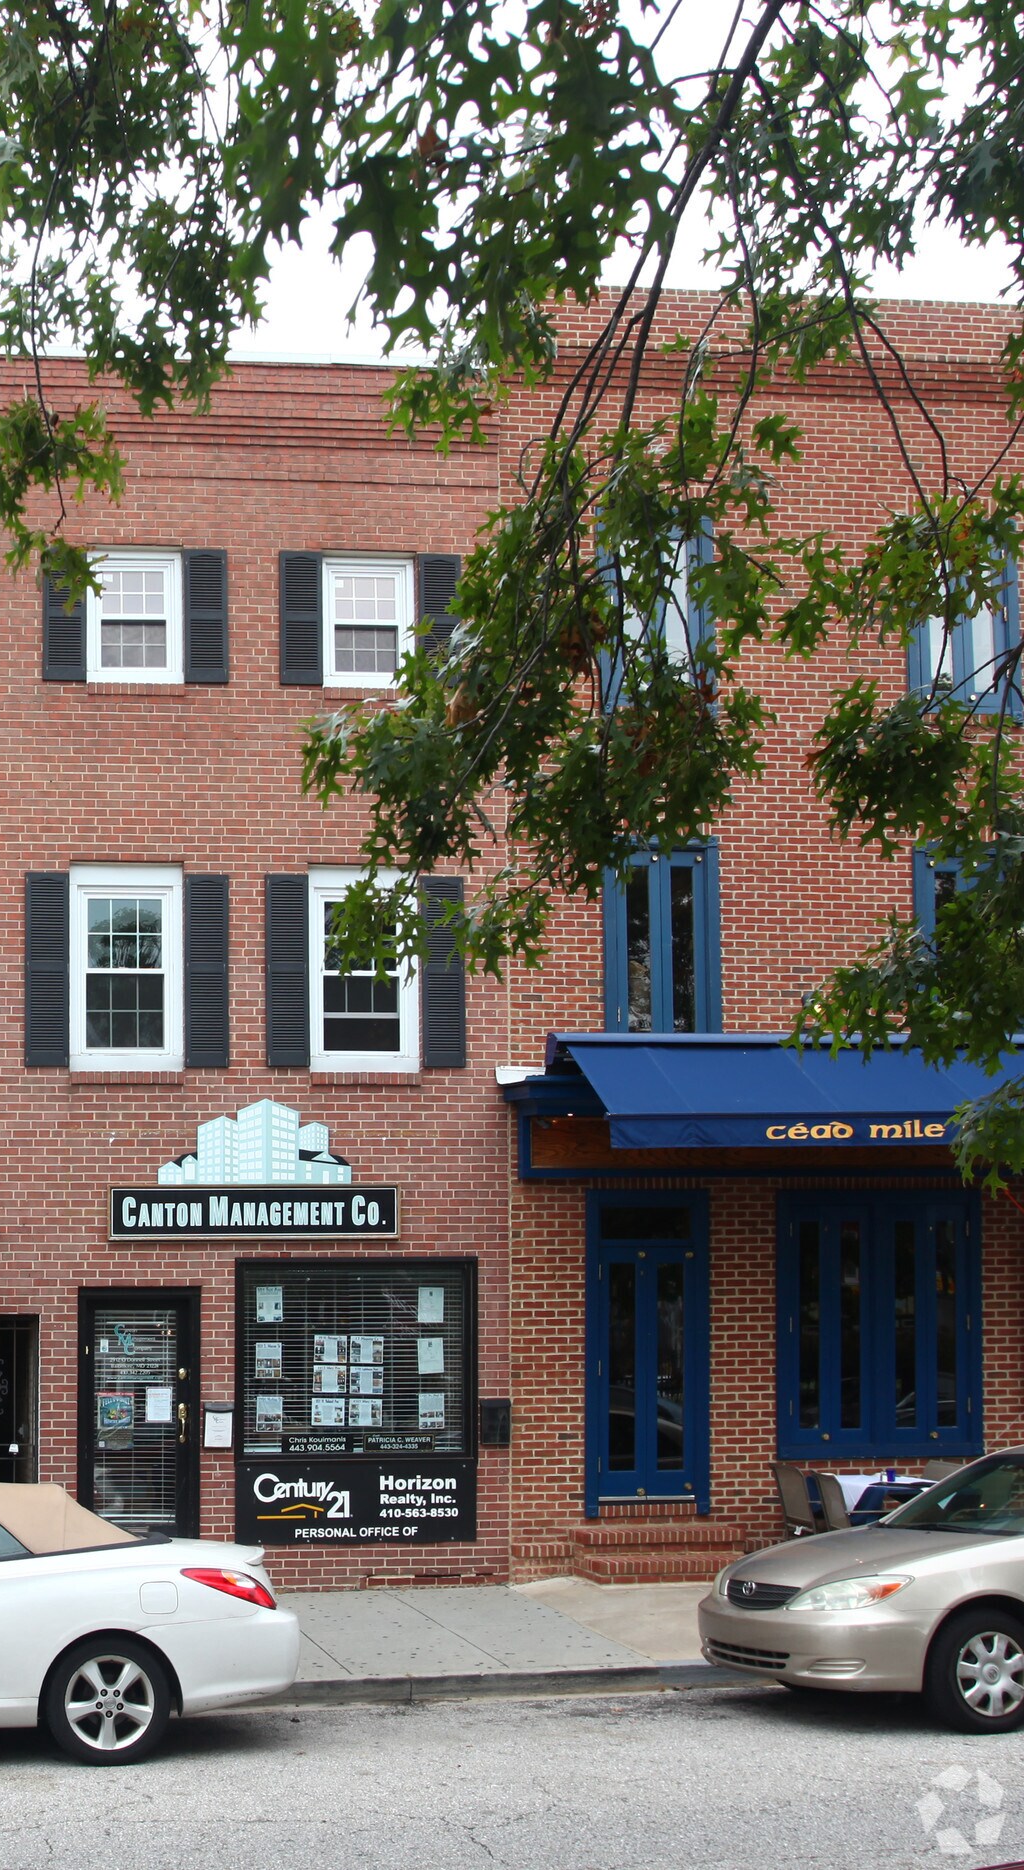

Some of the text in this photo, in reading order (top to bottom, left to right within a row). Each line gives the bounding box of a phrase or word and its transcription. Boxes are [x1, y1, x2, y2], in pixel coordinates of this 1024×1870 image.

[209, 1196, 344, 1227] MANAGEMENT
[289, 1436, 307, 1444] Chris
[379, 1474, 457, 1491] Horizon
[254, 1473, 351, 1518] Century 21
[380, 1493, 456, 1506] Realty, Inc.
[379, 1508, 459, 1518] 410-563-8530
[294, 1526, 418, 1538] PERSONAL OFFICE OF
